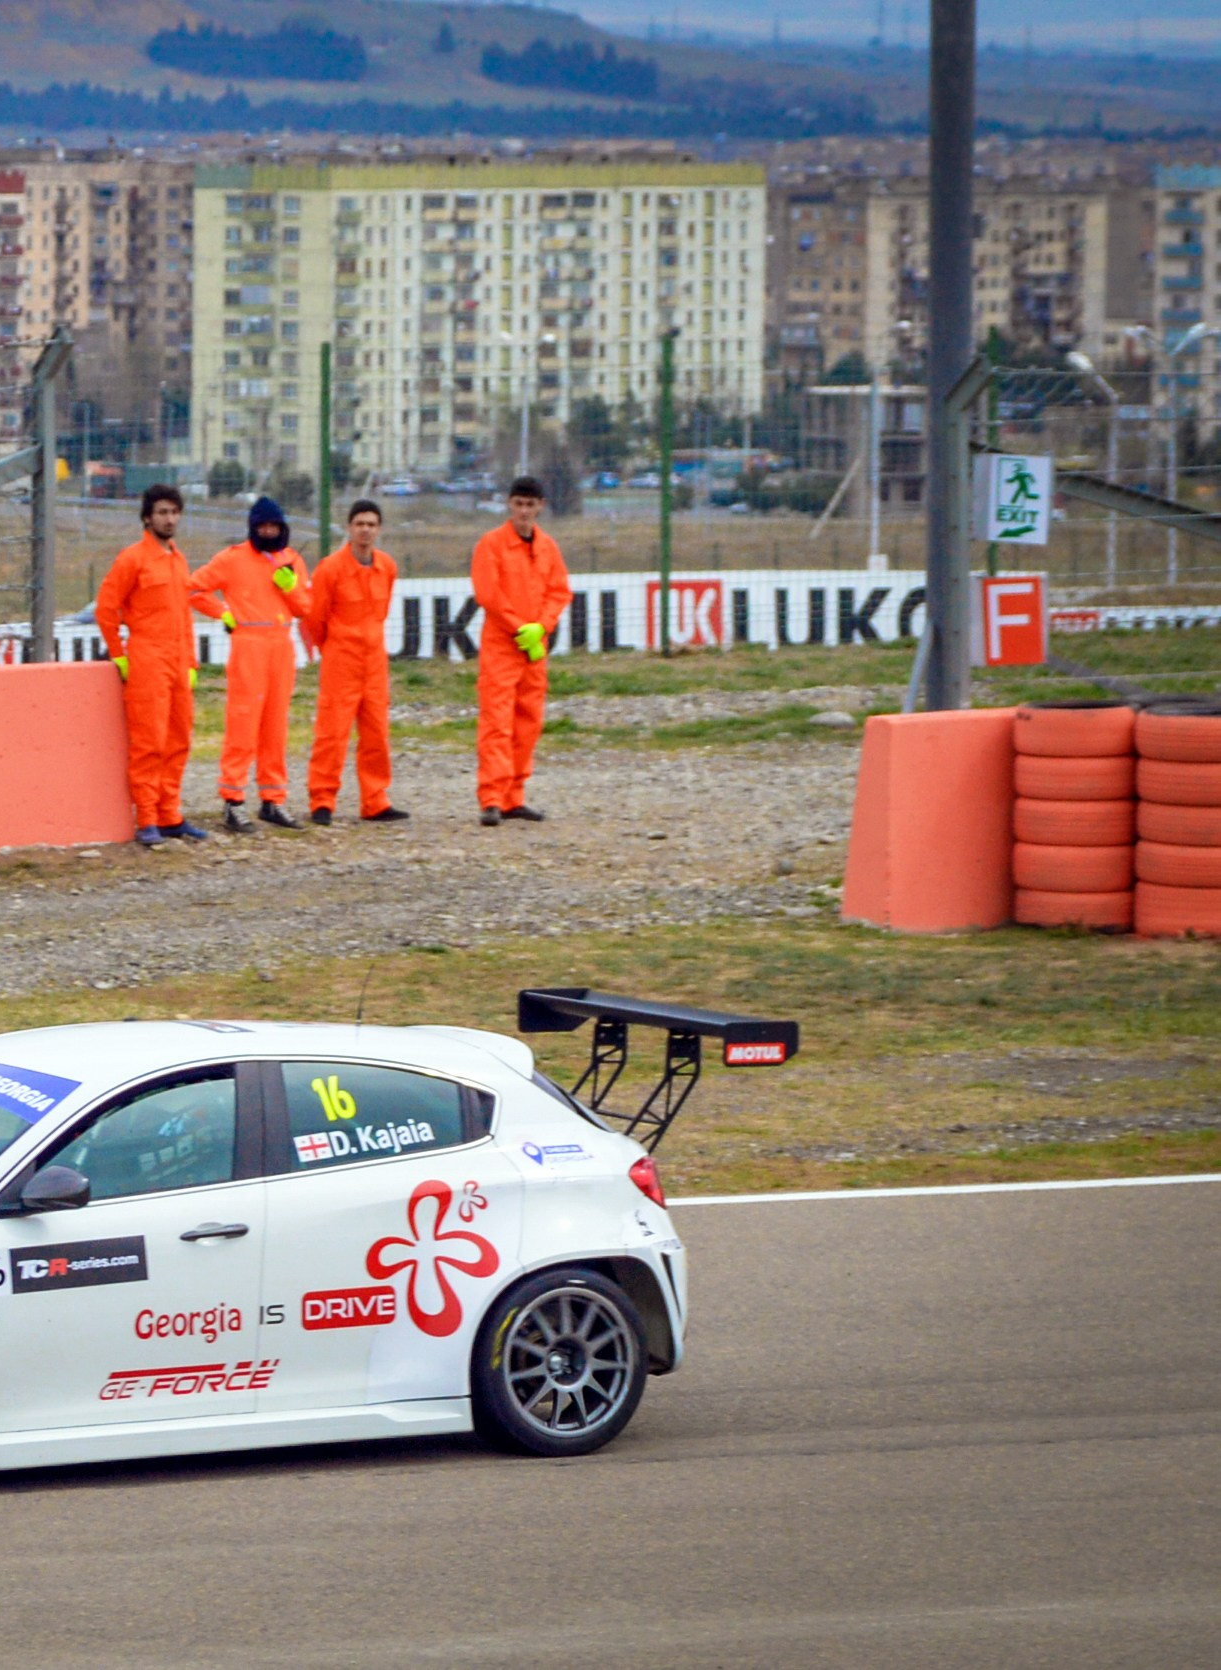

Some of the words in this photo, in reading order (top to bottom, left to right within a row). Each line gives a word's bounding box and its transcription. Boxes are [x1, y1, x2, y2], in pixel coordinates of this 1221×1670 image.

[996, 508, 1039, 524] EXIT
[987, 582, 1035, 661] F
[728, 1046, 782, 1060] MOTUL
[311, 1075, 357, 1122] 16
[328, 1130, 358, 1156] D.
[355, 1118, 435, 1153] Kajaia
[16, 1254, 140, 1280] TCR-series.com
[135, 1303, 242, 1343] Georgia
[259, 1304, 286, 1325] IS
[304, 1293, 395, 1321] DRIVE
[99, 1365, 277, 1401] GE-FORCE
